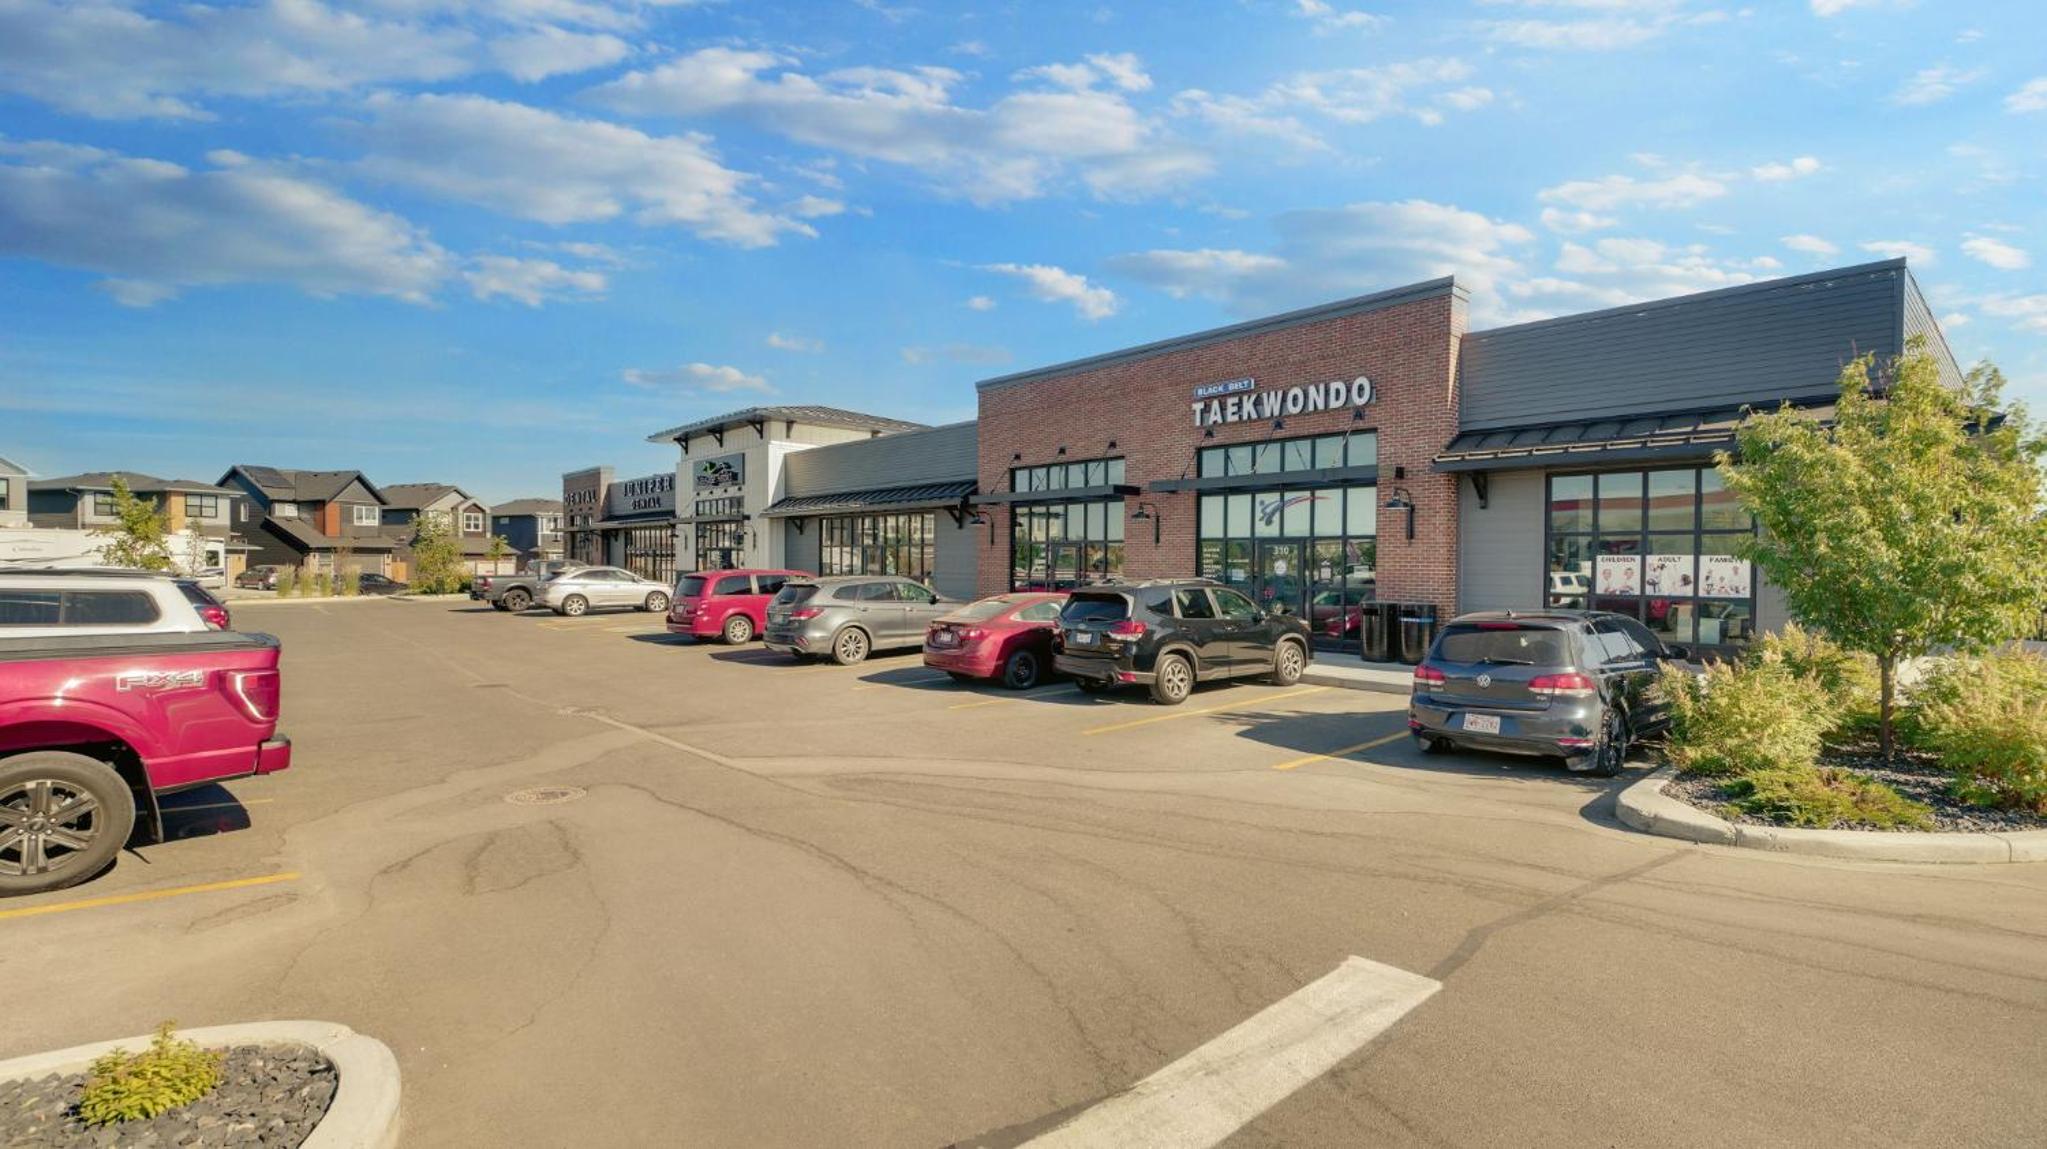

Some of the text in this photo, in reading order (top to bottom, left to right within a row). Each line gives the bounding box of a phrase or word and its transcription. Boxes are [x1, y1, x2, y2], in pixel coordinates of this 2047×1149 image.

[1197, 380, 1249, 396] BLACK BELT
[1192, 376, 1371, 426] TAEKWONDO
[624, 475, 672, 497] JUNIPER
[565, 489, 597, 506] DENTAL
[631, 496, 661, 510] DENTAL
[1601, 556, 1636, 564] CHILDREN
[1709, 556, 1744, 564] FAMILY
[116, 670, 204, 692] FX4
